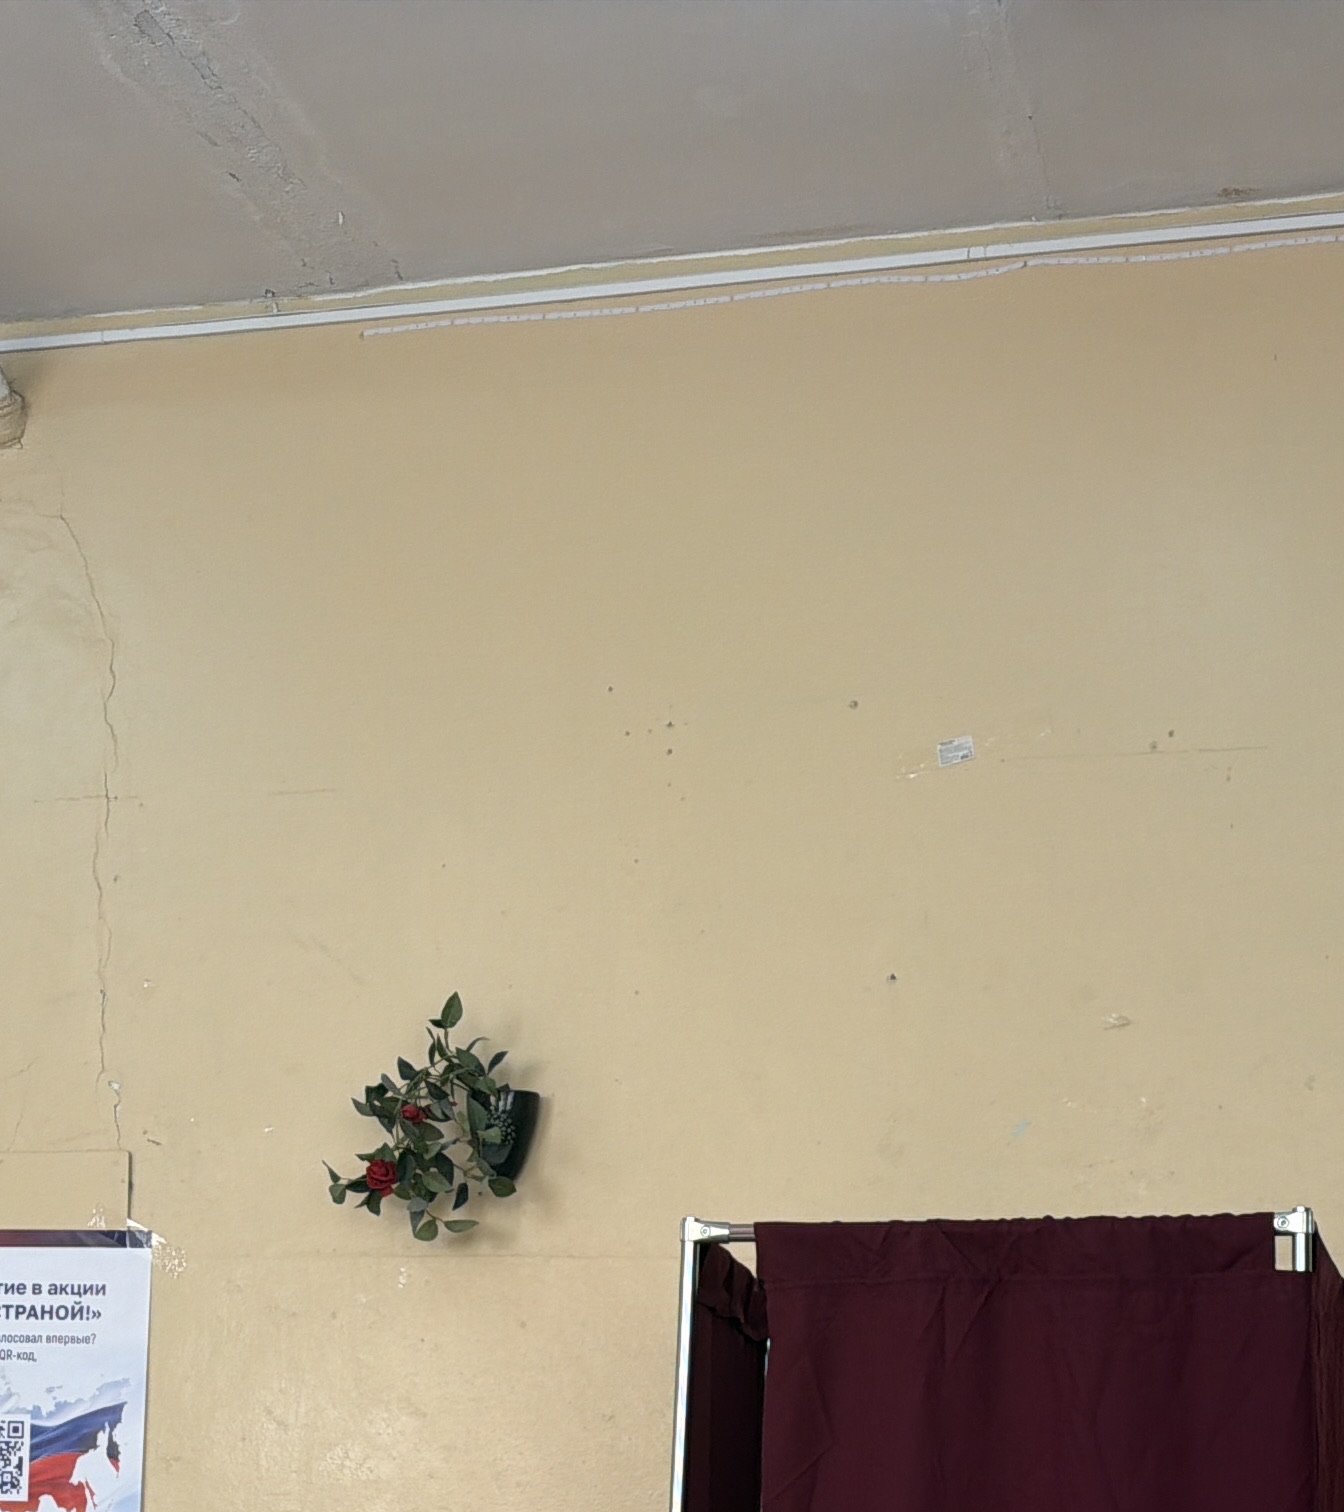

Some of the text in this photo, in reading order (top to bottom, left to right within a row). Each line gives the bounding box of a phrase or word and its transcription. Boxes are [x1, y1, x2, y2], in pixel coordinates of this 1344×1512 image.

[31, 1283, 43, 1296] в
[47, 1283, 107, 1298] акции
[45, 1333, 97, 1347] впервые?
